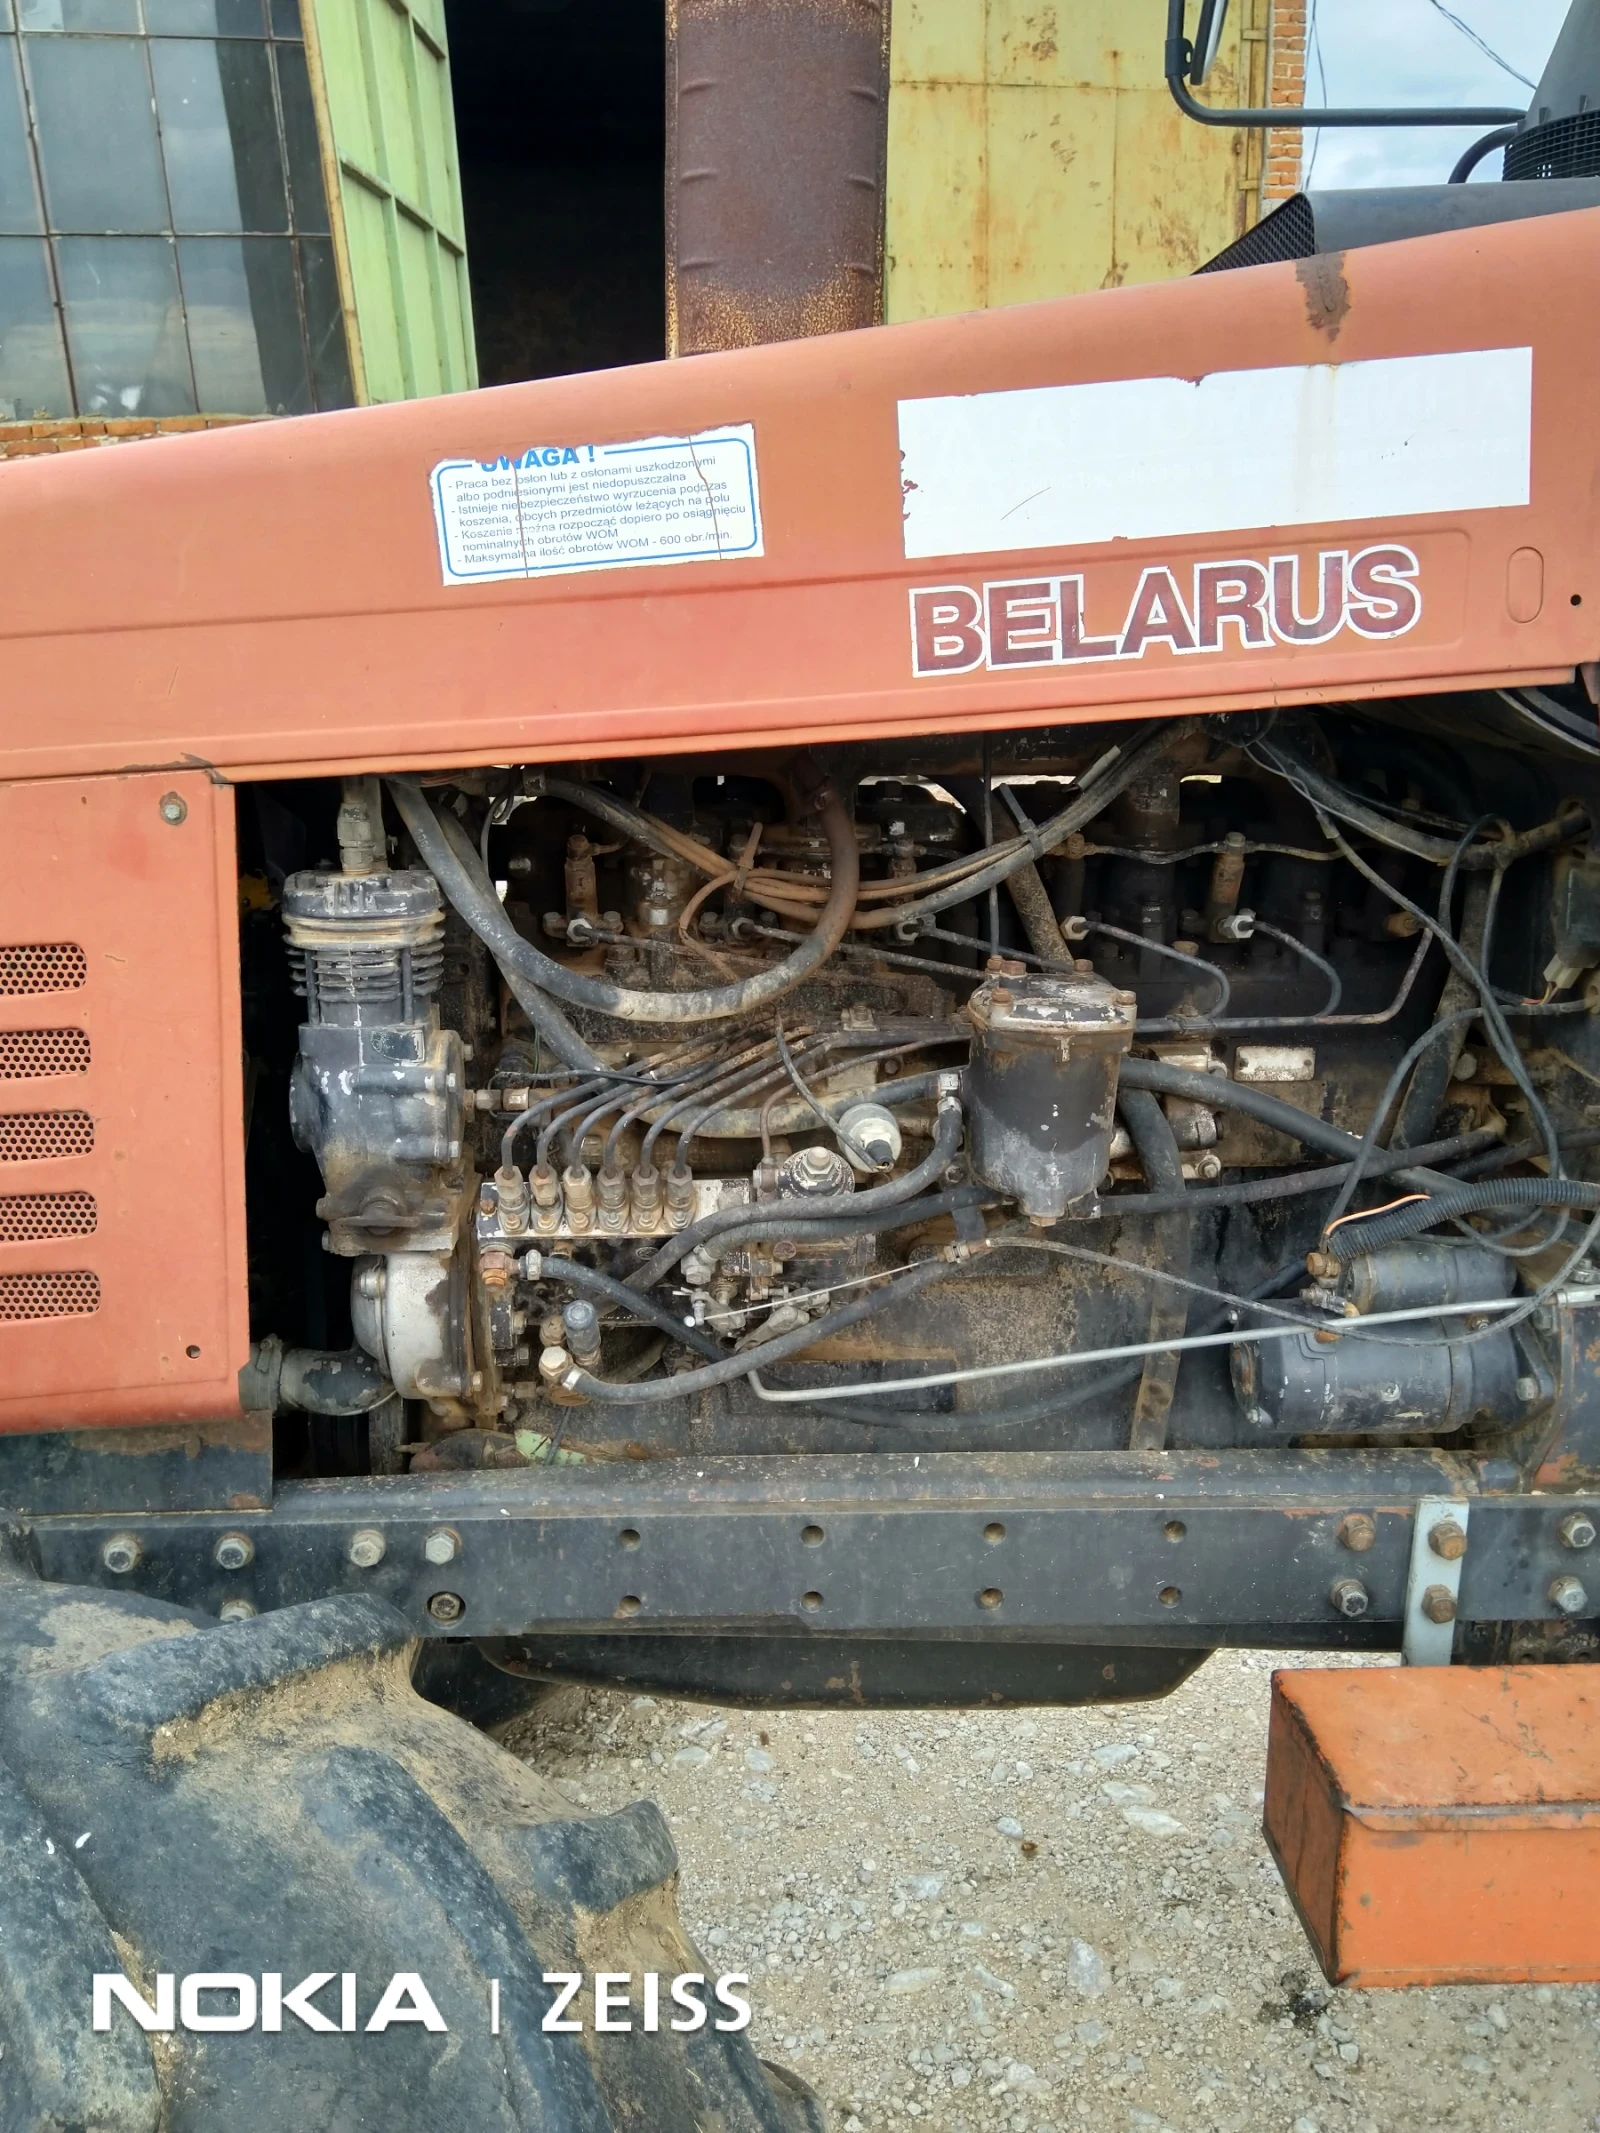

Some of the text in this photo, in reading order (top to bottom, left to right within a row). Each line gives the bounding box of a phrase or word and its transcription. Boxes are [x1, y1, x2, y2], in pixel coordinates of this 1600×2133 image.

[588, 445, 595, 462] !
[456, 479, 488, 489] Praca
[492, 478, 512, 486] bez
[516, 474, 547, 484] osłon
[550, 471, 567, 480] lub
[581, 465, 632, 477] osłonami
[636, 456, 716, 472] uszkodzonymi
[457, 473, 686, 502] albo podniesionymi jest niedopuszczalna
[459, 503, 498, 515] Istnieje
[613, 487, 676, 501] wyrzucenia
[680, 482, 727, 495] podczas
[460, 493, 730, 527] koszenia, obcych przedmiotów leżących na polu
[462, 526, 513, 539] Koszenie
[560, 516, 616, 530] rozpocząć
[620, 512, 662, 525] dopiero
[666, 512, 679, 522] po
[683, 505, 745, 518] osiągnięciu
[463, 529, 618, 551] nominalnych obrotów WOM
[465, 550, 536, 563] Maksymalna
[540, 546, 565, 556] ilość
[569, 543, 614, 554] obrotów
[616, 538, 648, 549] WOM
[660, 535, 680, 545] 600
[685, 531, 732, 543] obr./min.
[908, 544, 1421, 678] BELARUS
